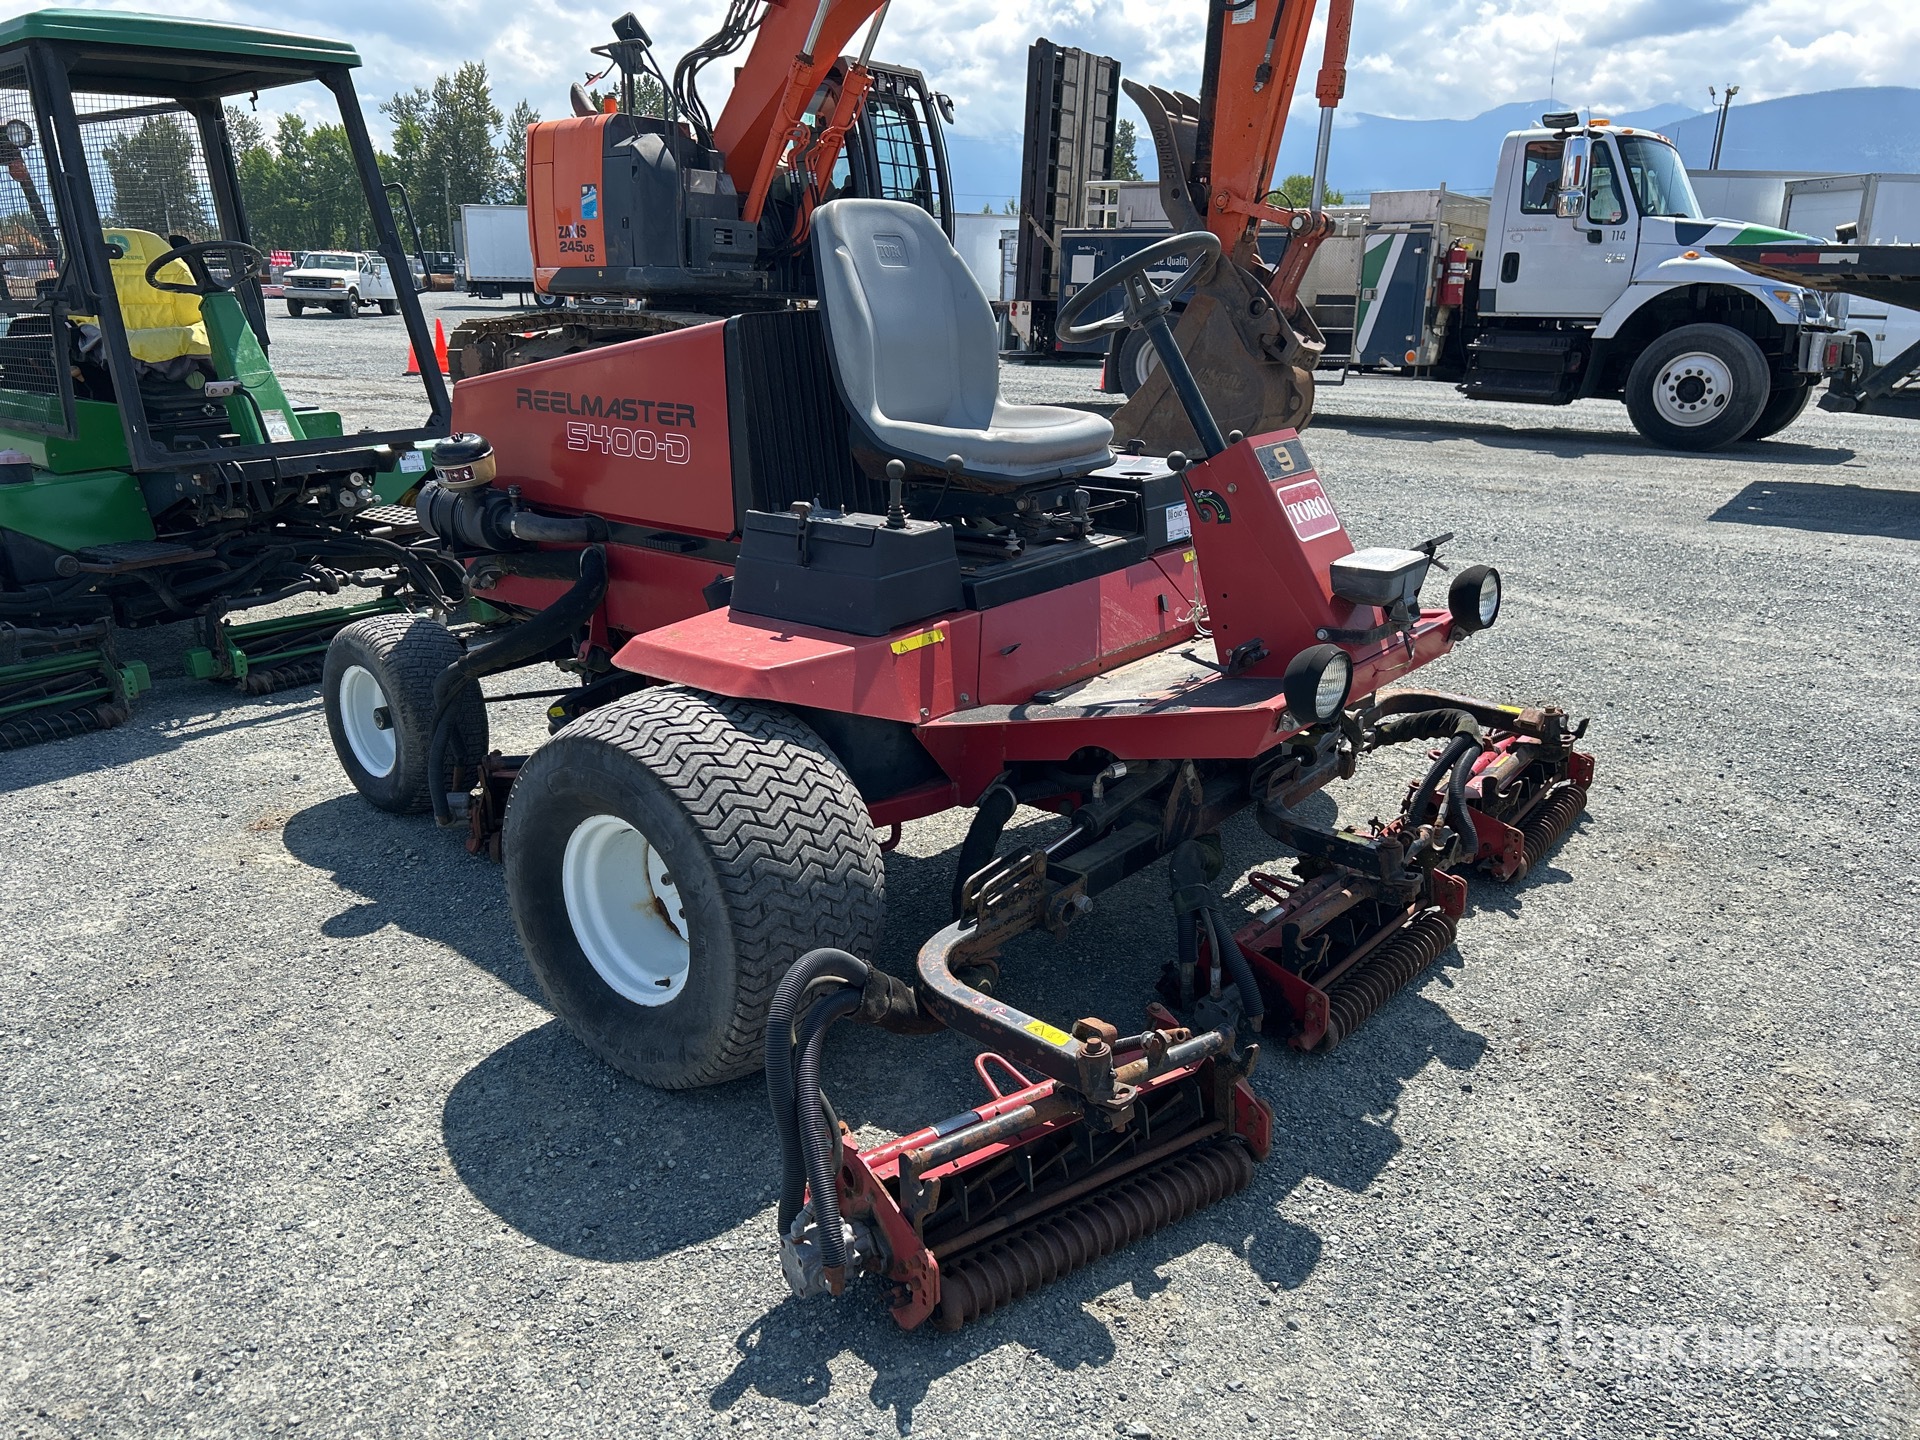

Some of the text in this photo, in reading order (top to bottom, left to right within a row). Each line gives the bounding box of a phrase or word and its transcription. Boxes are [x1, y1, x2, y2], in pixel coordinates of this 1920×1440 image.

[558, 222, 587, 239] ZAXIS
[1611, 230, 1626, 241] 114
[584, 254, 595, 262] LC
[516, 388, 696, 428] REELMASTER
[566, 421, 691, 465] 5400-D
[1273, 446, 1295, 472] 9
